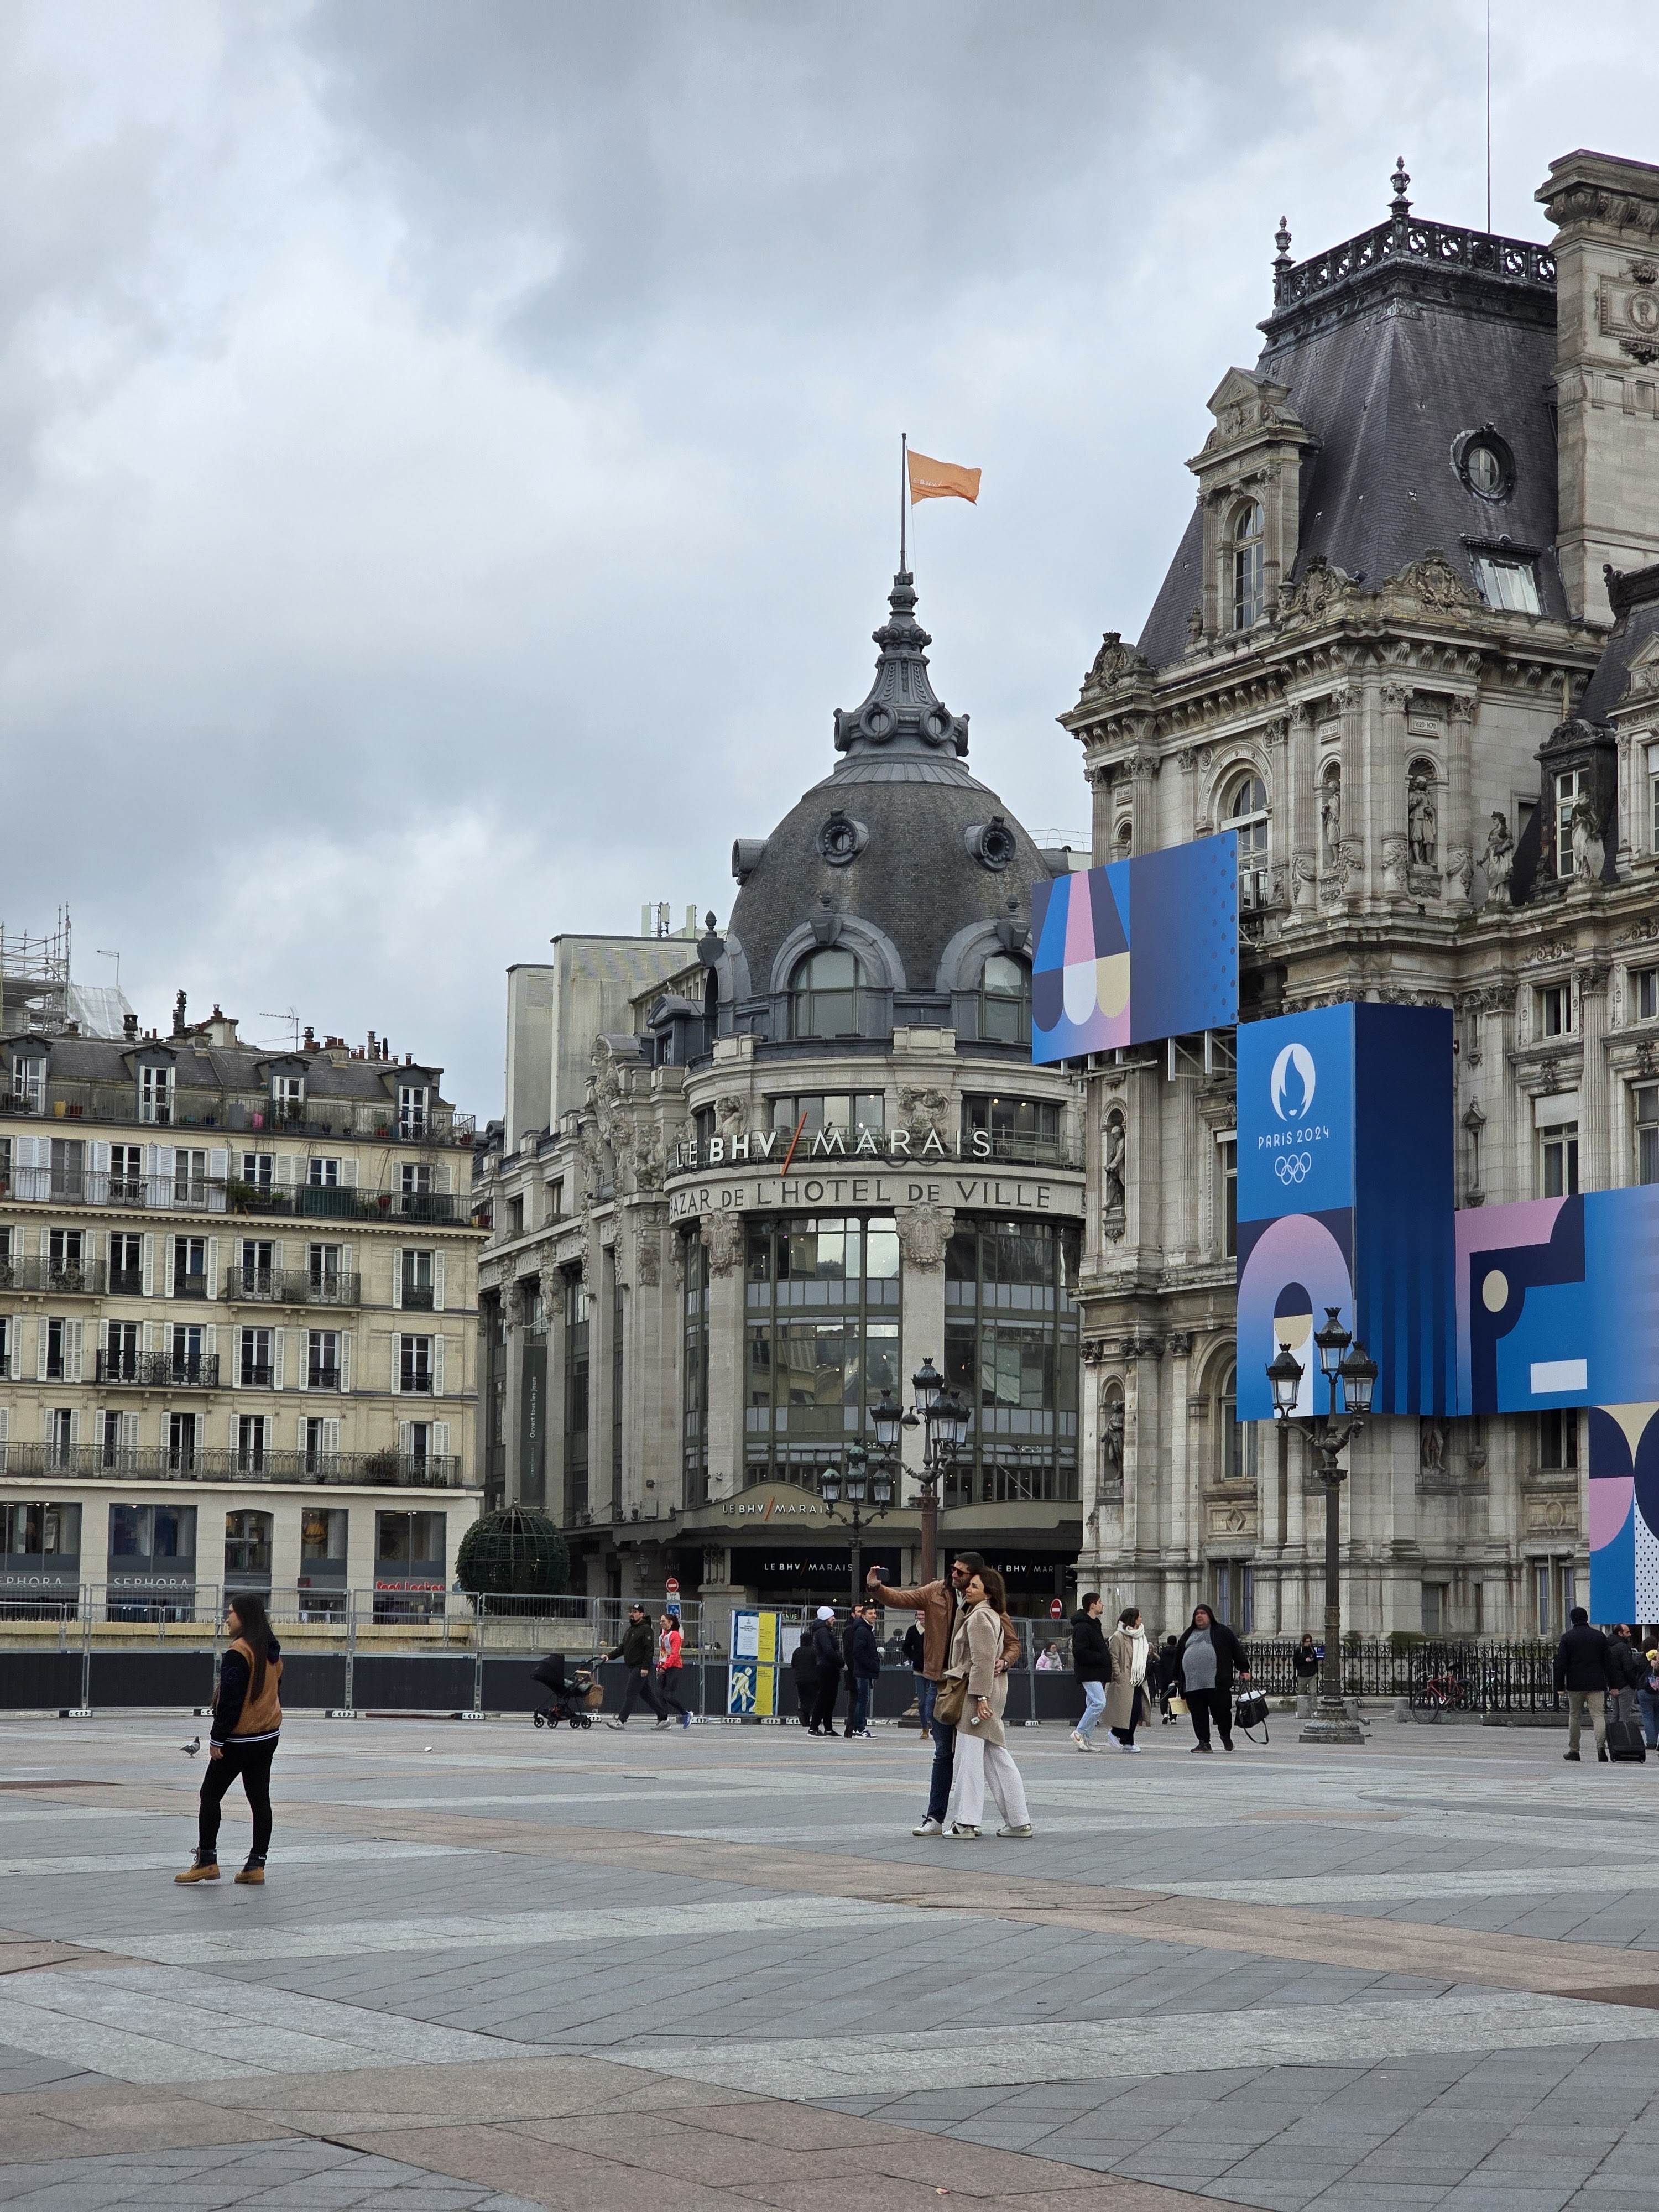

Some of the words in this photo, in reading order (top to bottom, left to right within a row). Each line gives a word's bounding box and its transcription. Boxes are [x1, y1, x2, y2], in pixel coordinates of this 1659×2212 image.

[1297, 1125, 1329, 1143] 2024
[676, 1140, 698, 1168] LE
[709, 1131, 776, 1162] BHV
[811, 1128, 991, 1156] MARAIS
[670, 1188, 712, 1220] BAZAR
[722, 1188, 743, 1207] DE
[757, 1180, 891, 1205] L'HOTEL
[907, 1183, 940, 1202] DE
[956, 1180, 1050, 1208] VILLE
[723, 1504, 735, 1514] LE
[739, 1504, 764, 1514] BHV
[114, 1577, 190, 1589] SEPHORA
[376, 1580, 401, 1591] Foot
